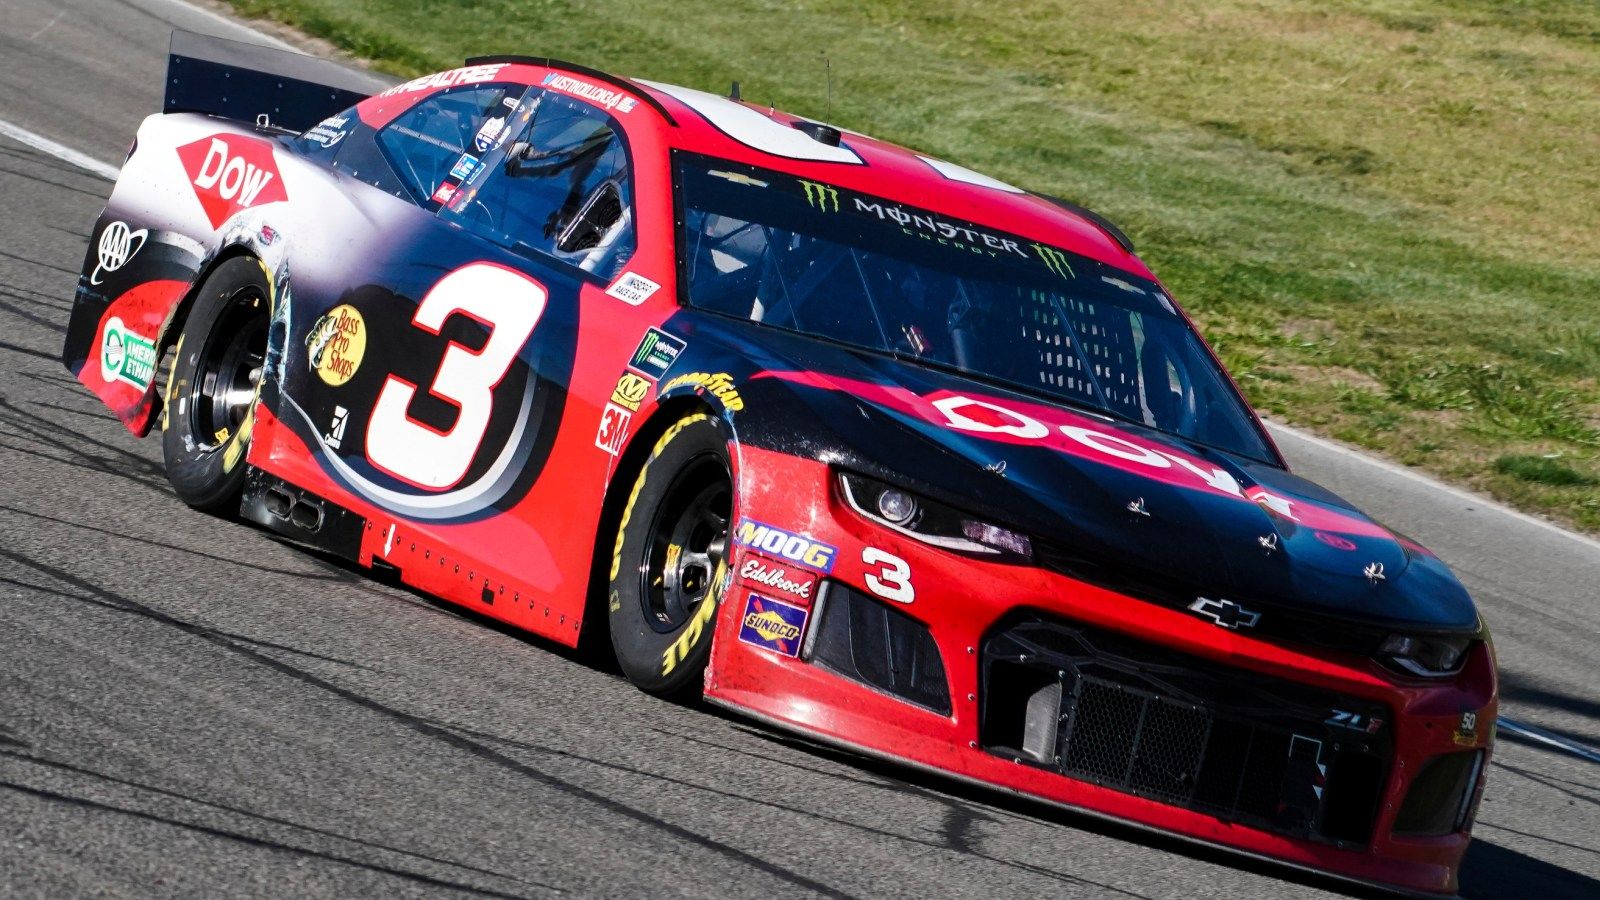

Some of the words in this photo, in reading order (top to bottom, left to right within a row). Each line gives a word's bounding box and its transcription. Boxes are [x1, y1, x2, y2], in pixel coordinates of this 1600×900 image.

[193, 138, 274, 207] DOW
[854, 198, 1029, 259] MONSTER
[903, 229, 997, 257] ENERGY
[337, 309, 360, 335] Bass
[331, 331, 350, 353] Pro
[327, 350, 355, 379] Shops
[365, 260, 548, 491] 3
[738, 520, 834, 570] MOOG
[740, 559, 812, 600] Edelbrock
[861, 545, 915, 604] 3
[747, 614, 798, 639] SUNOCO
[1461, 711, 1476, 730] 50
